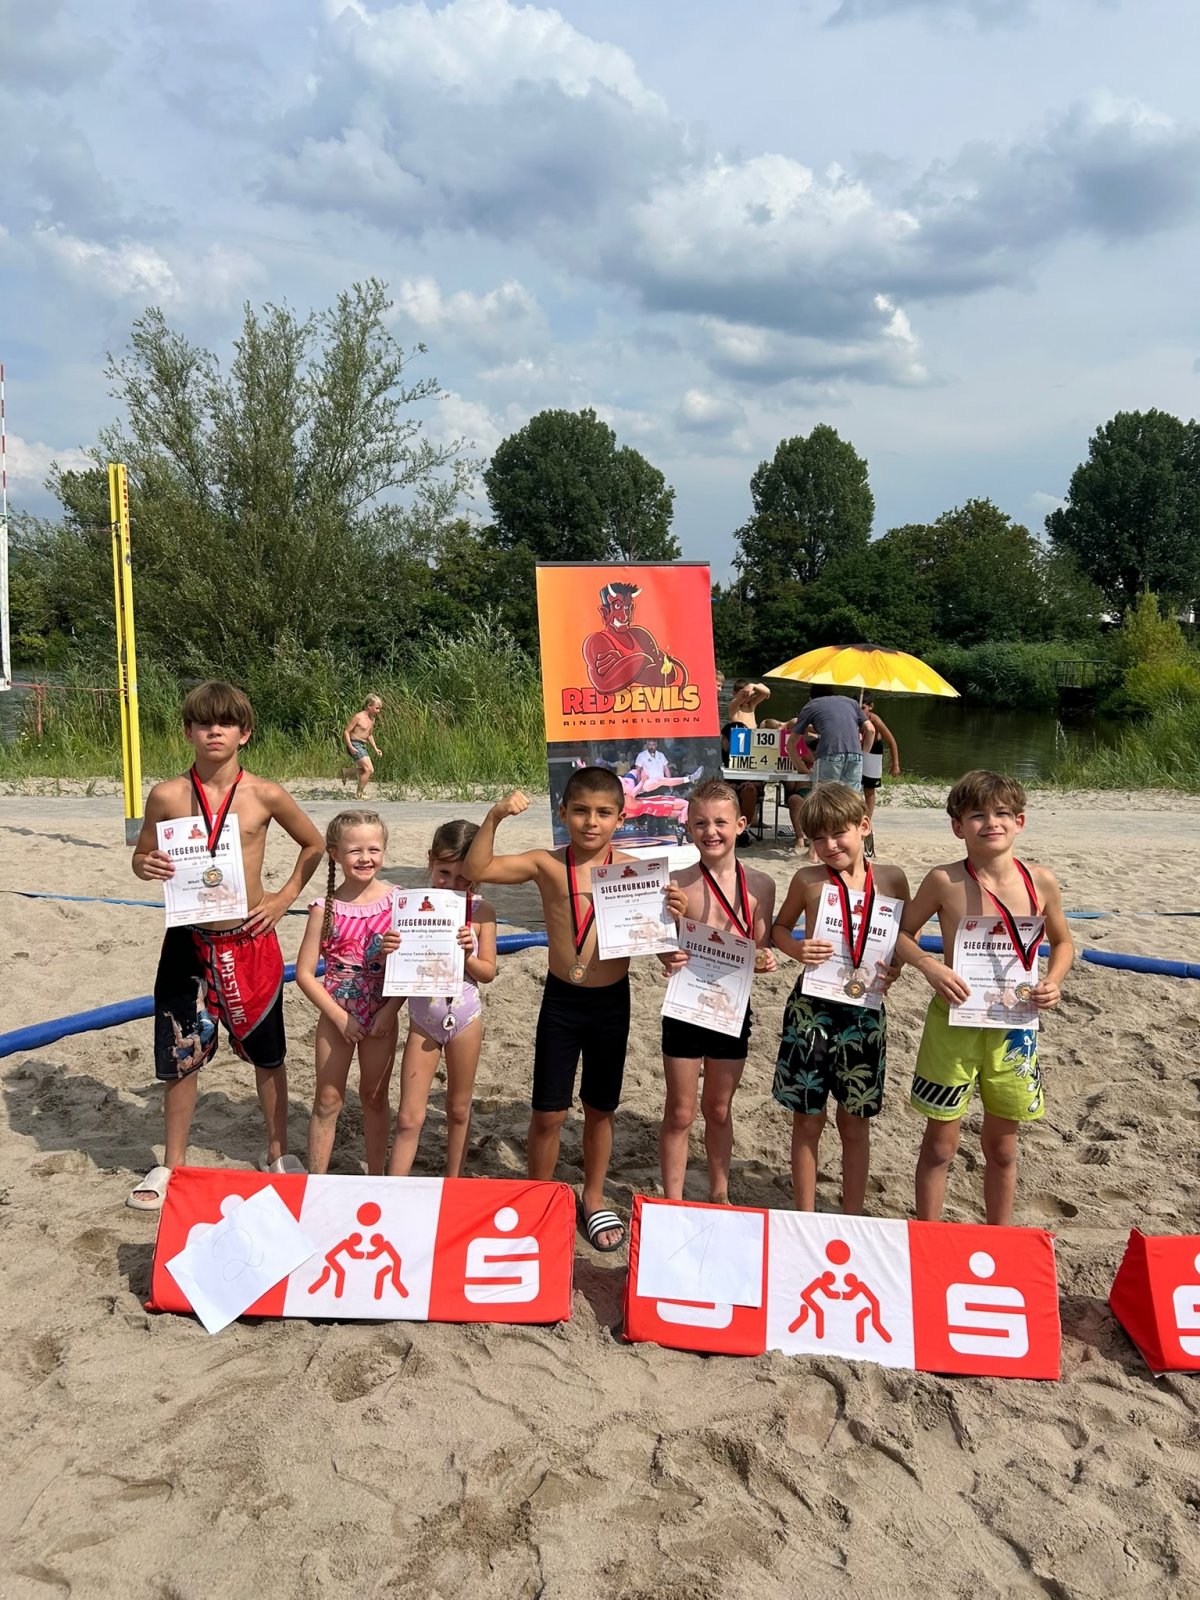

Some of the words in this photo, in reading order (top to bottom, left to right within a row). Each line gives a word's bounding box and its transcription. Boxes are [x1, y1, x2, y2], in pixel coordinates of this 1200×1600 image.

[563, 719, 616, 727] RINGEN
[622, 717, 700, 725] HEILBRONN
[737, 732, 746, 753] 1
[756, 733, 775, 746] 130
[760, 755, 768, 766] 4
[600, 879, 661, 894] SIEGERURKUNDE
[685, 940, 745, 965] SIEGERURKUNDE
[219, 949, 247, 1025] WRESTLING
